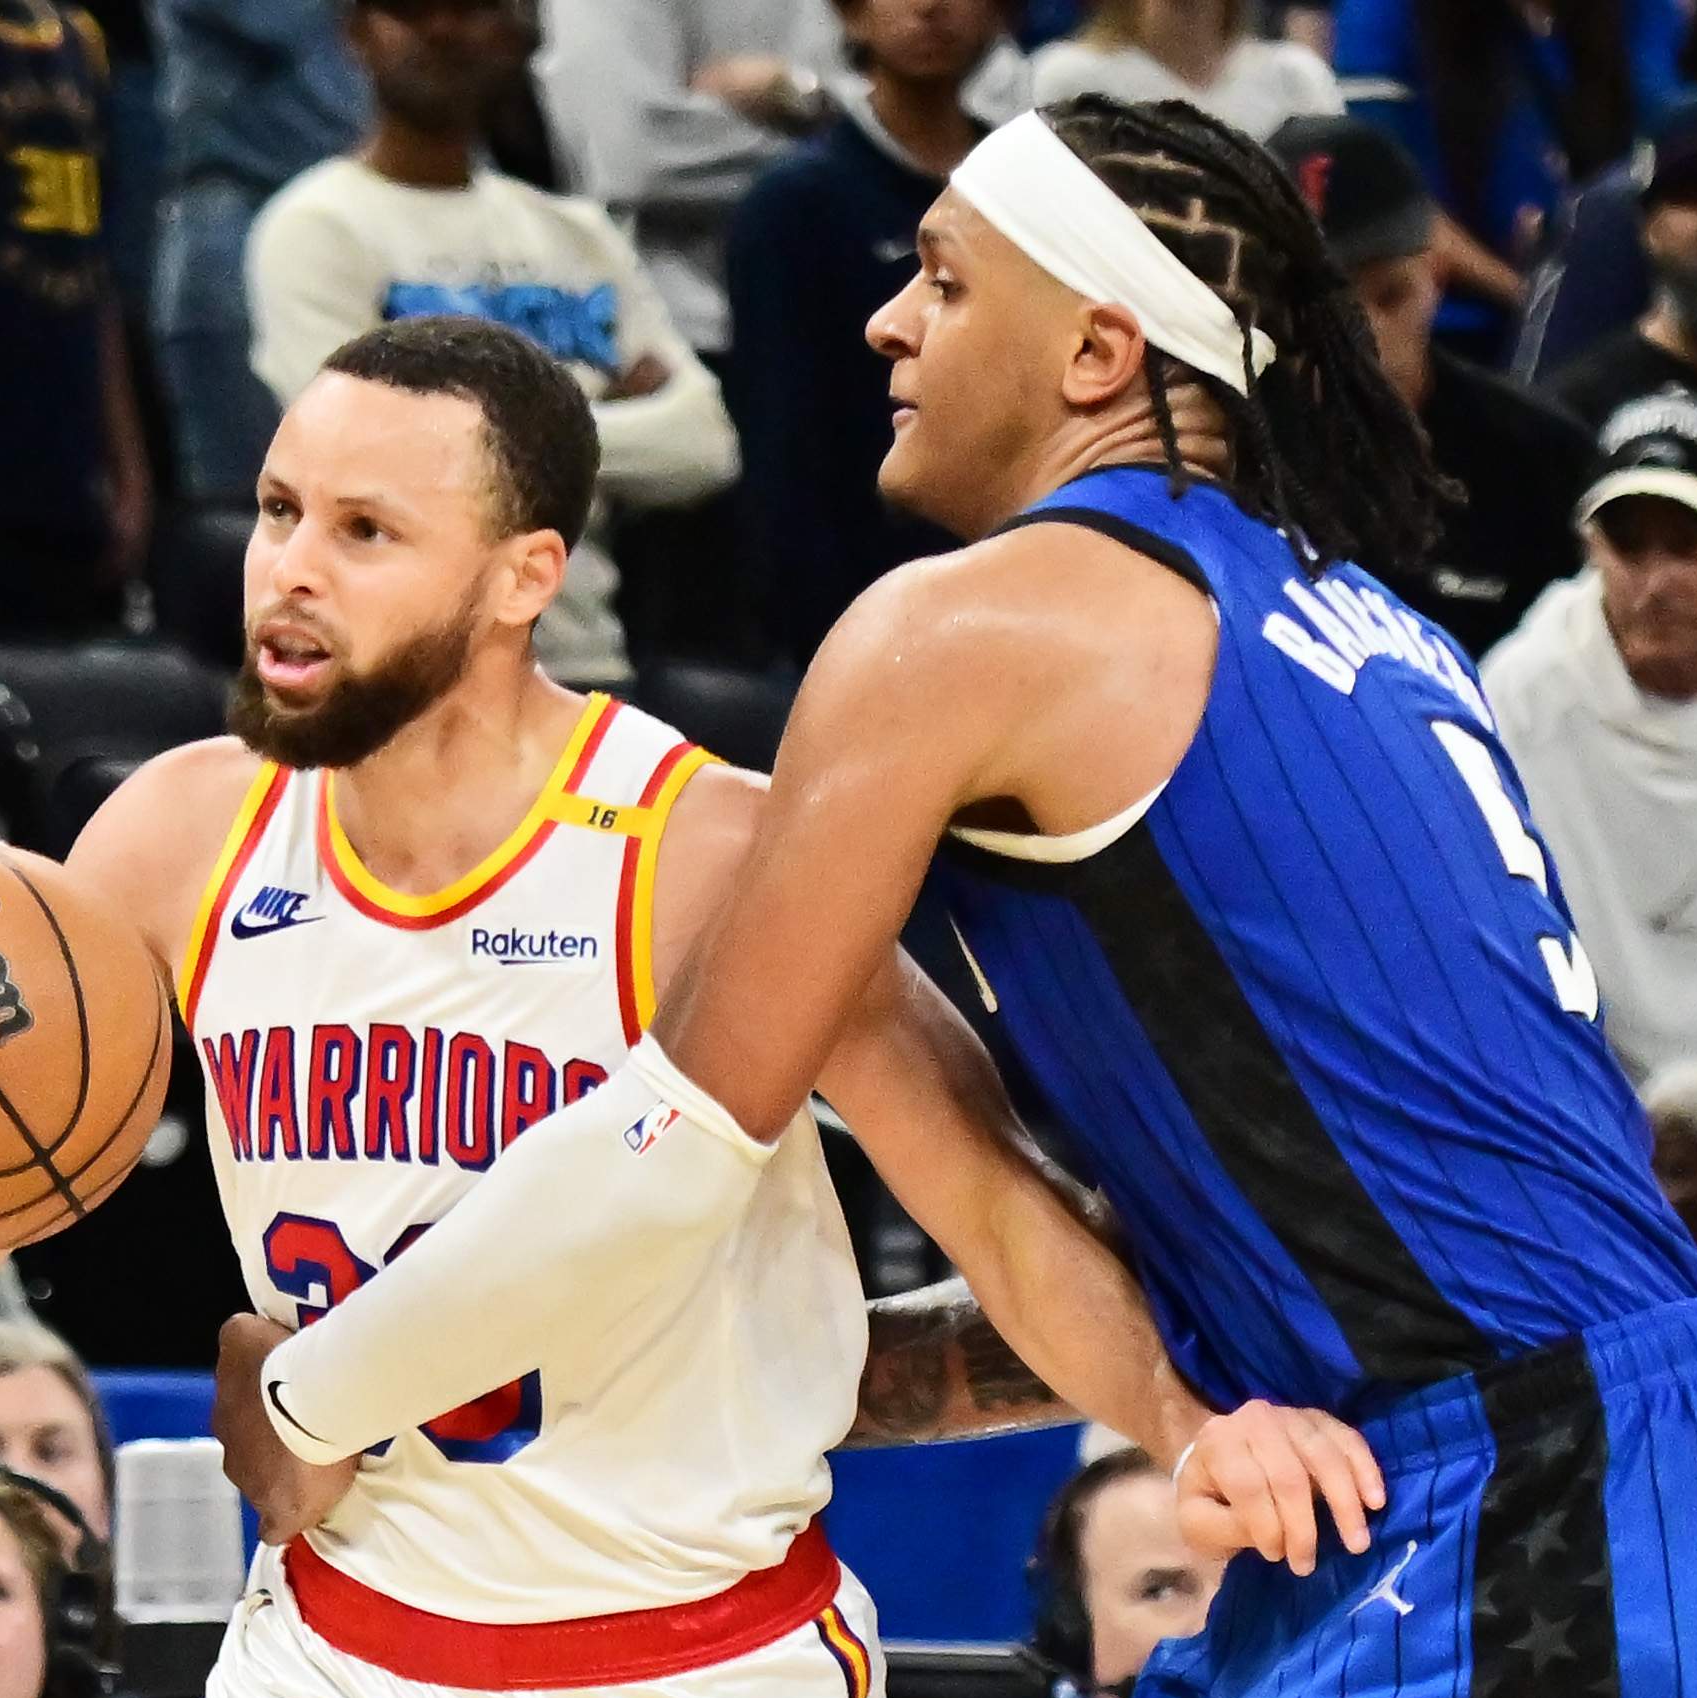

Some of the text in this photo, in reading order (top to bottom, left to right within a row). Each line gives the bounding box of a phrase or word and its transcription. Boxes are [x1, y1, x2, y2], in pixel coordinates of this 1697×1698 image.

[587, 805, 618, 829] 16
[248, 886, 310, 921] NIKE
[471, 928, 598, 959] Rakuten
